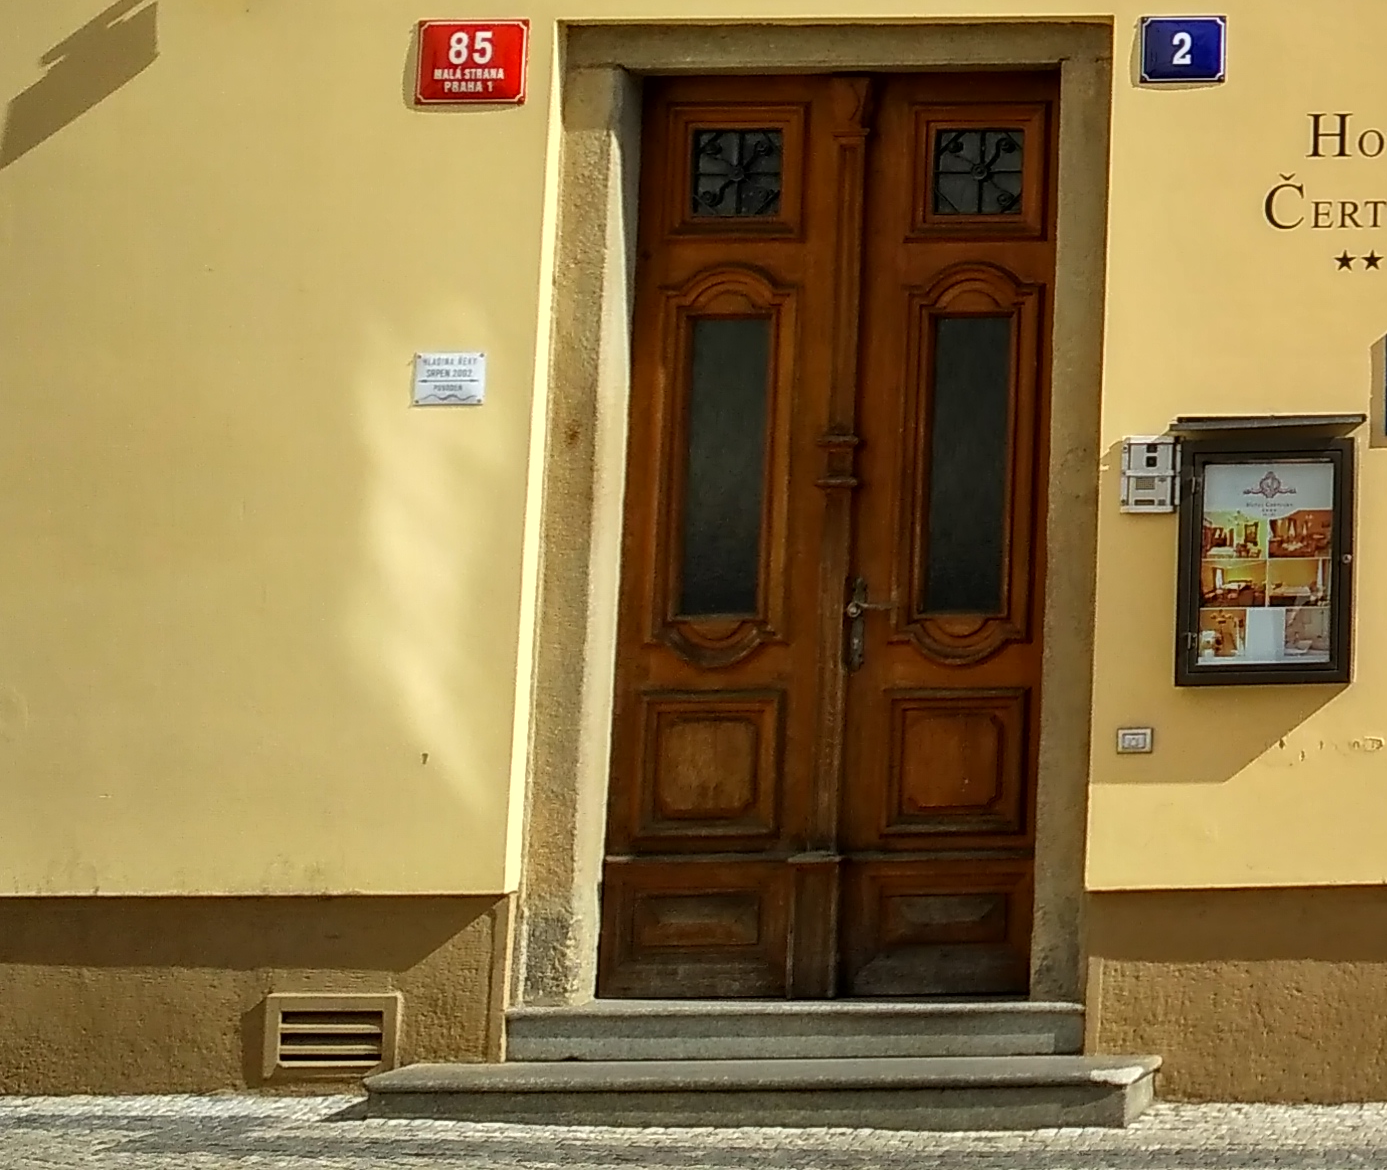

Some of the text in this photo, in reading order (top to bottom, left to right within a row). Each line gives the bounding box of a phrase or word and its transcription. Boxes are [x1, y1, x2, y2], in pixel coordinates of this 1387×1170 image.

[448, 31, 493, 65] 85
[1172, 31, 1192, 65] 2
[433, 66, 505, 80] MALÁ STRANA
[444, 81, 493, 93] PRAHA 1
